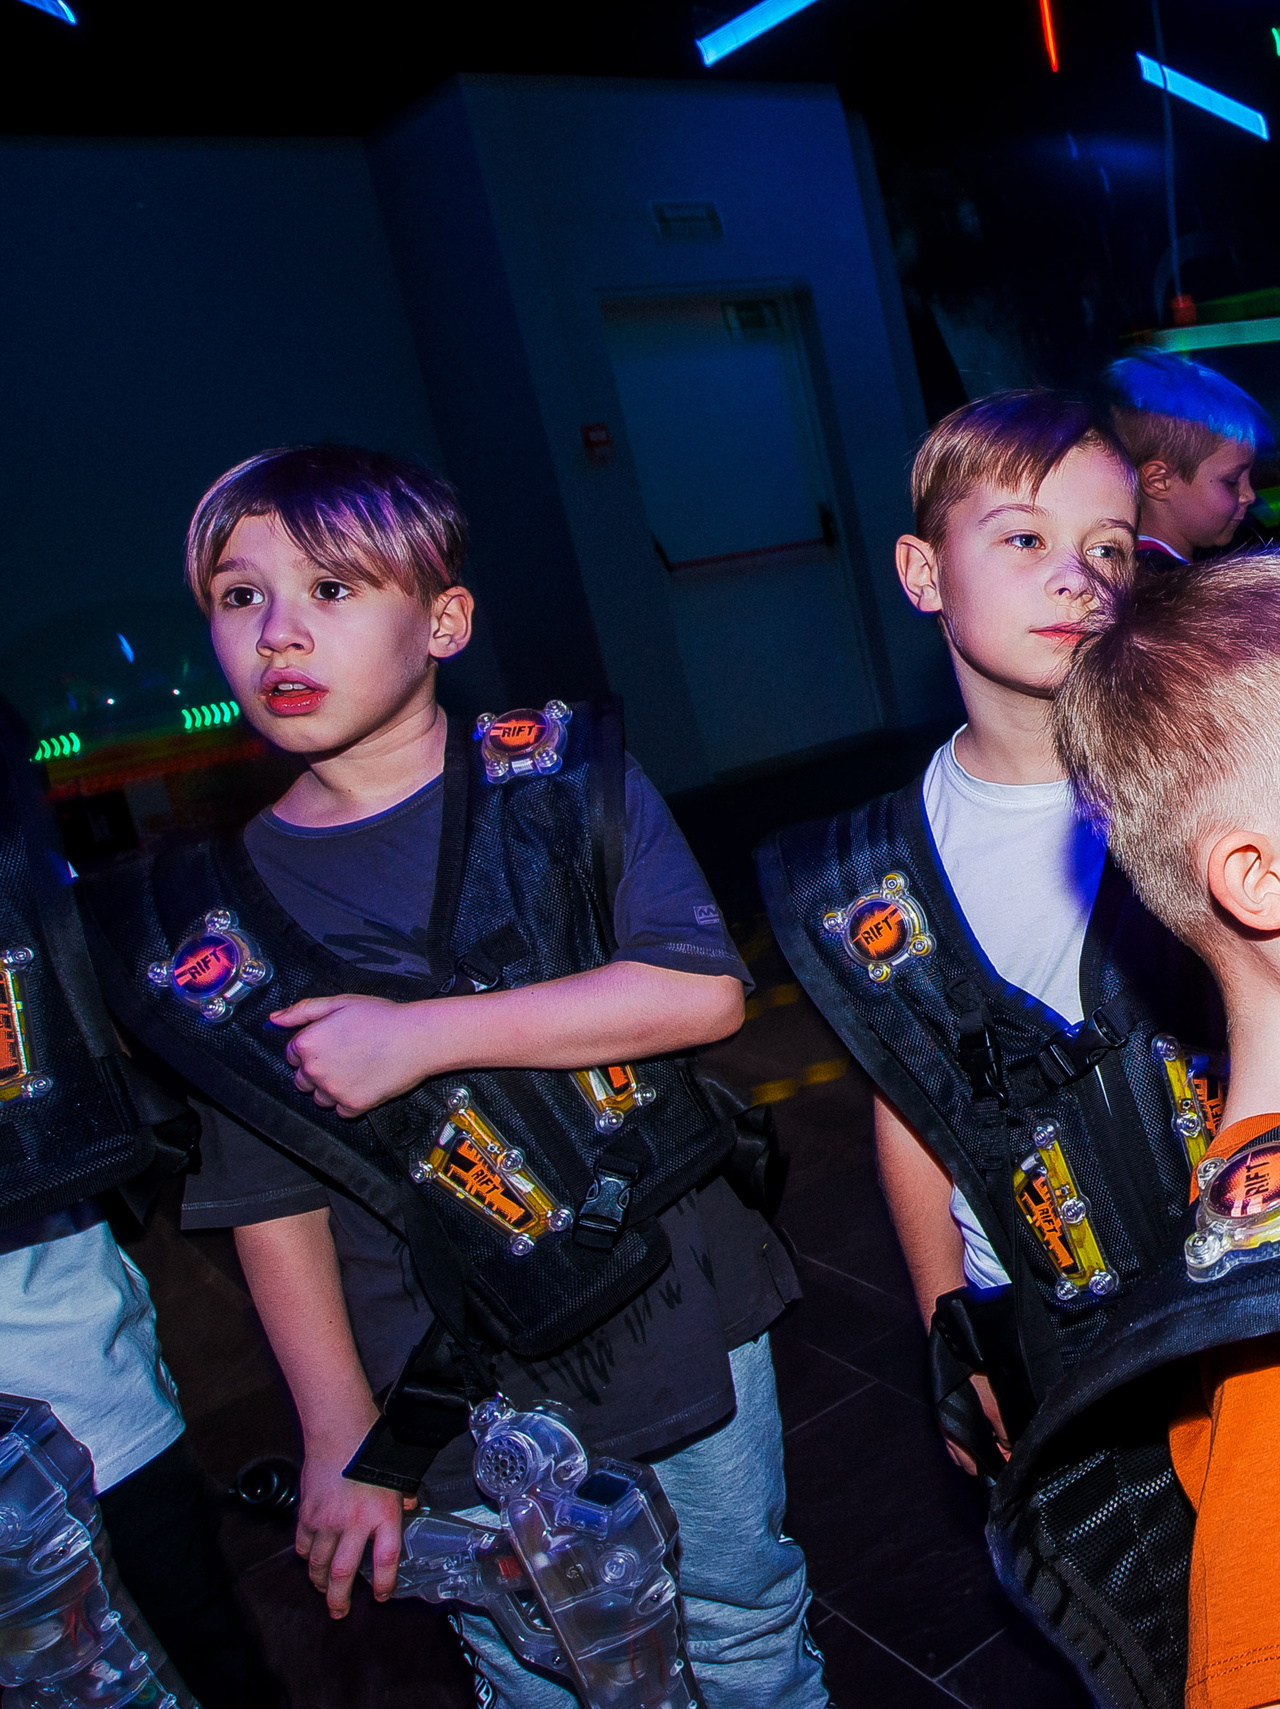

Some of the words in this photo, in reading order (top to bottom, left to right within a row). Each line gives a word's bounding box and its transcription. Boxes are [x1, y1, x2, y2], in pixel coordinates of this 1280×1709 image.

[501, 724, 536, 738] RIFT
[861, 916, 893, 945] RIFT
[186, 949, 221, 980] RIFT
[471, 1169, 500, 1194] RIFT
[1245, 1162, 1270, 1198] RIFT
[1038, 1207, 1058, 1233] RIFT
